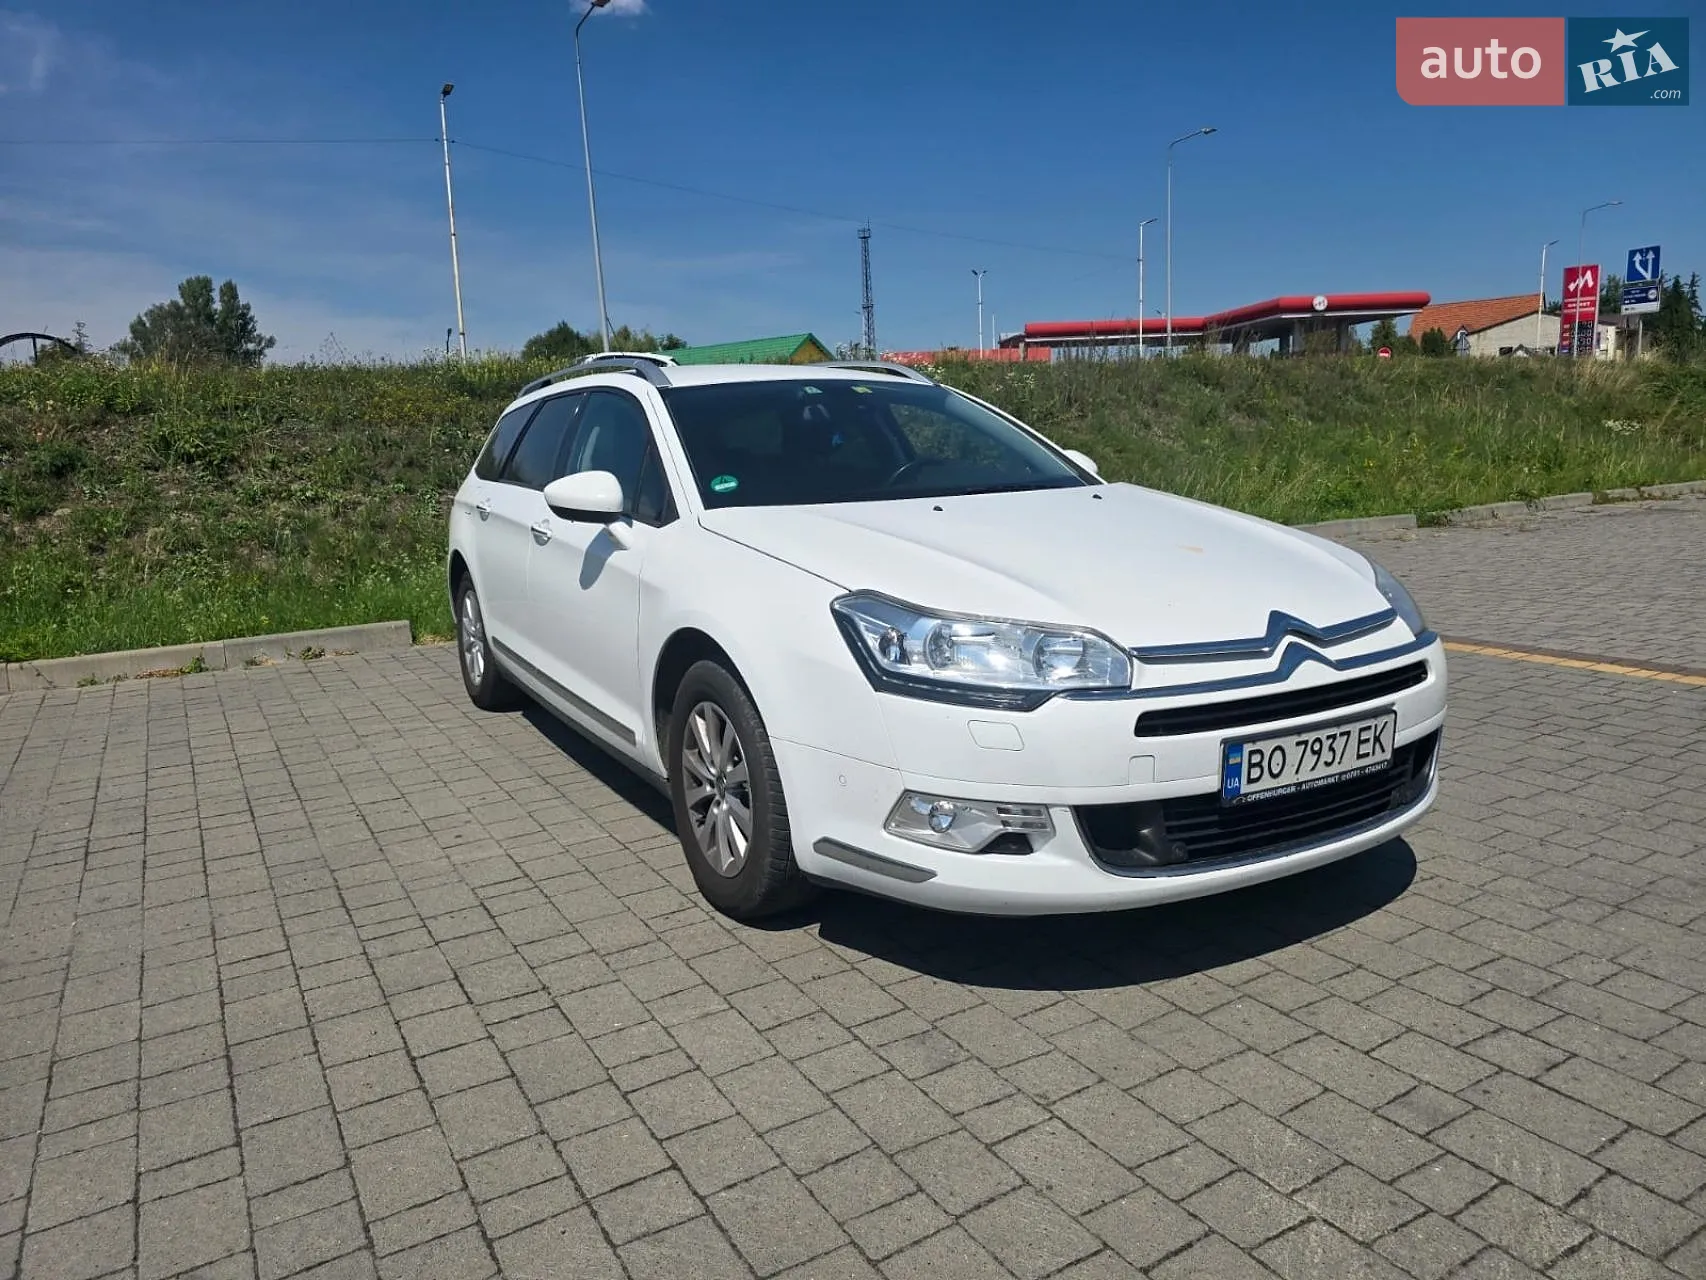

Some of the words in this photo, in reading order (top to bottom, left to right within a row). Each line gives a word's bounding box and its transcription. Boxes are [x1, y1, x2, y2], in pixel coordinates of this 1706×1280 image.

[1246, 744, 1287, 786] BO
[1294, 730, 1351, 776] 7937
[1356, 720, 1388, 760] EK
[1227, 776, 1239, 789] UA
